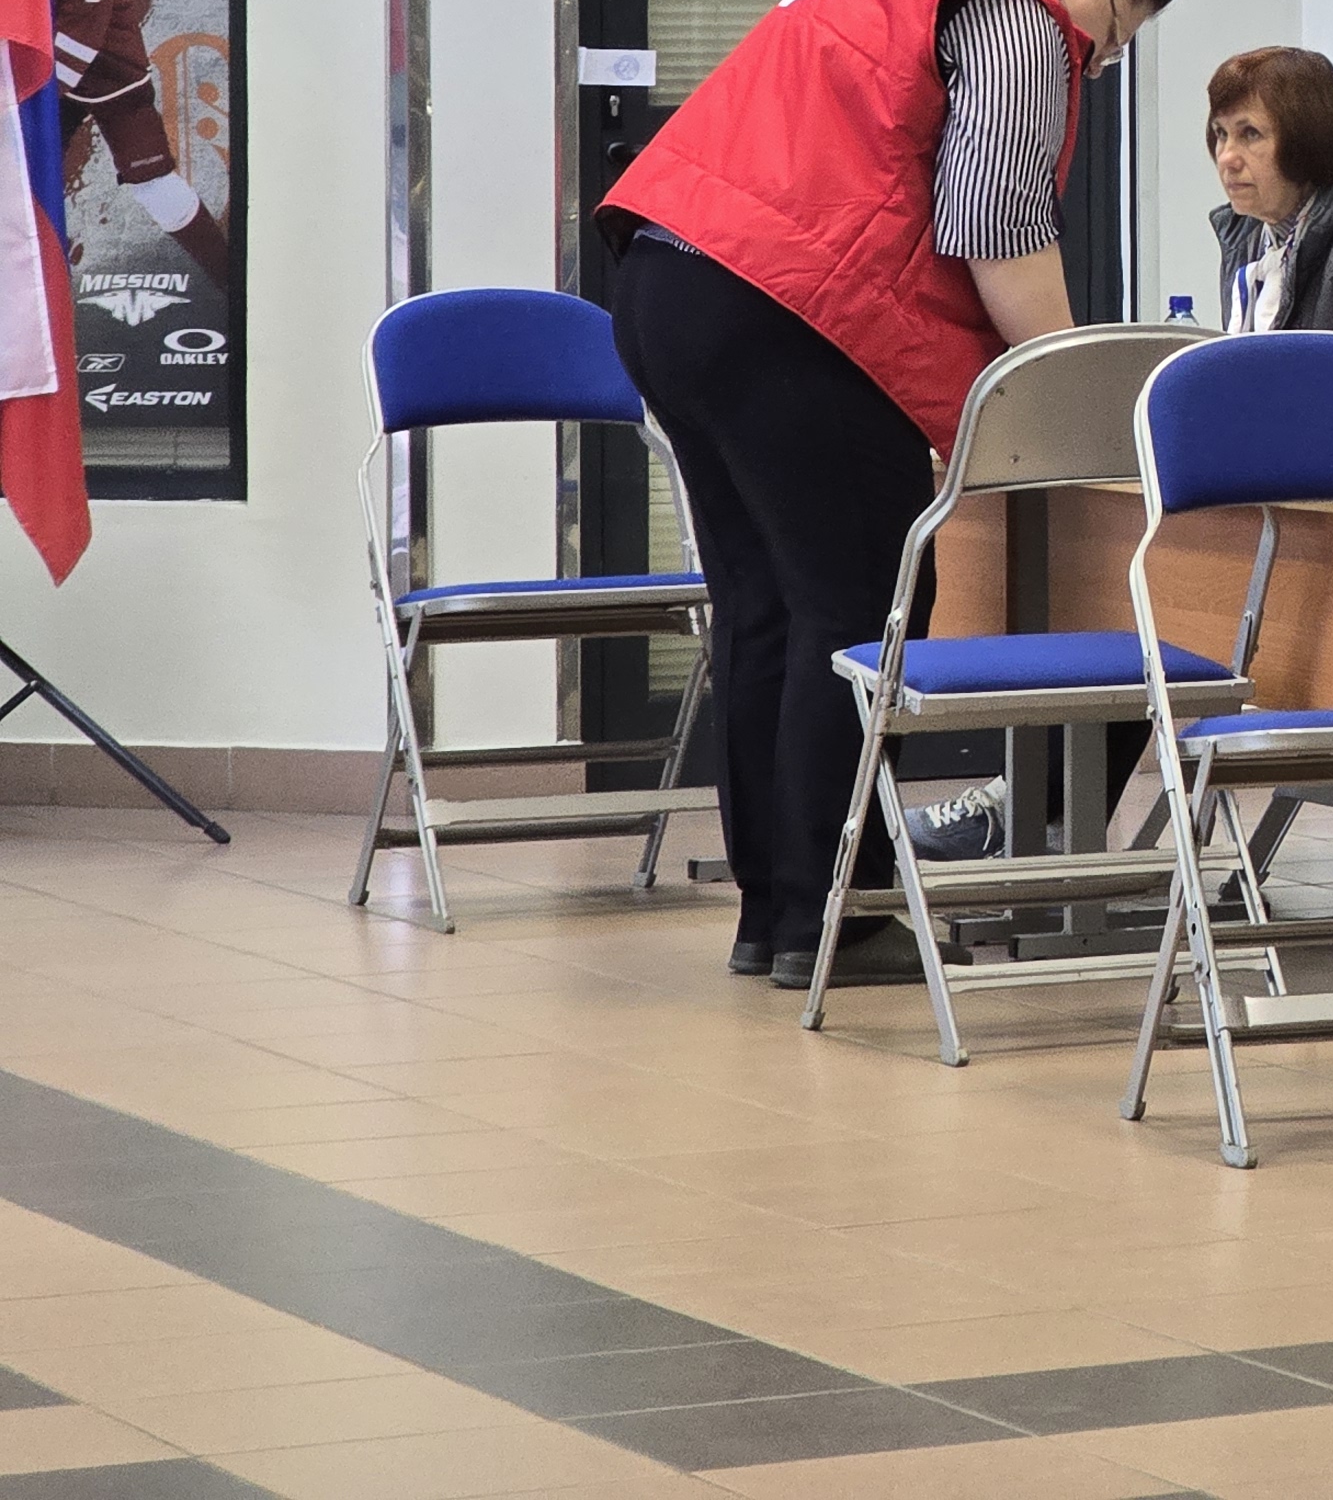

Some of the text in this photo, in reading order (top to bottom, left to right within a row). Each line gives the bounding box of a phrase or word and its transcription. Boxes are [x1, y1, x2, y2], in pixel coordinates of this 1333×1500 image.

[79, 274, 190, 293] MISSION
[160, 353, 229, 365] OAKLEY
[109, 391, 212, 406] EASTON
